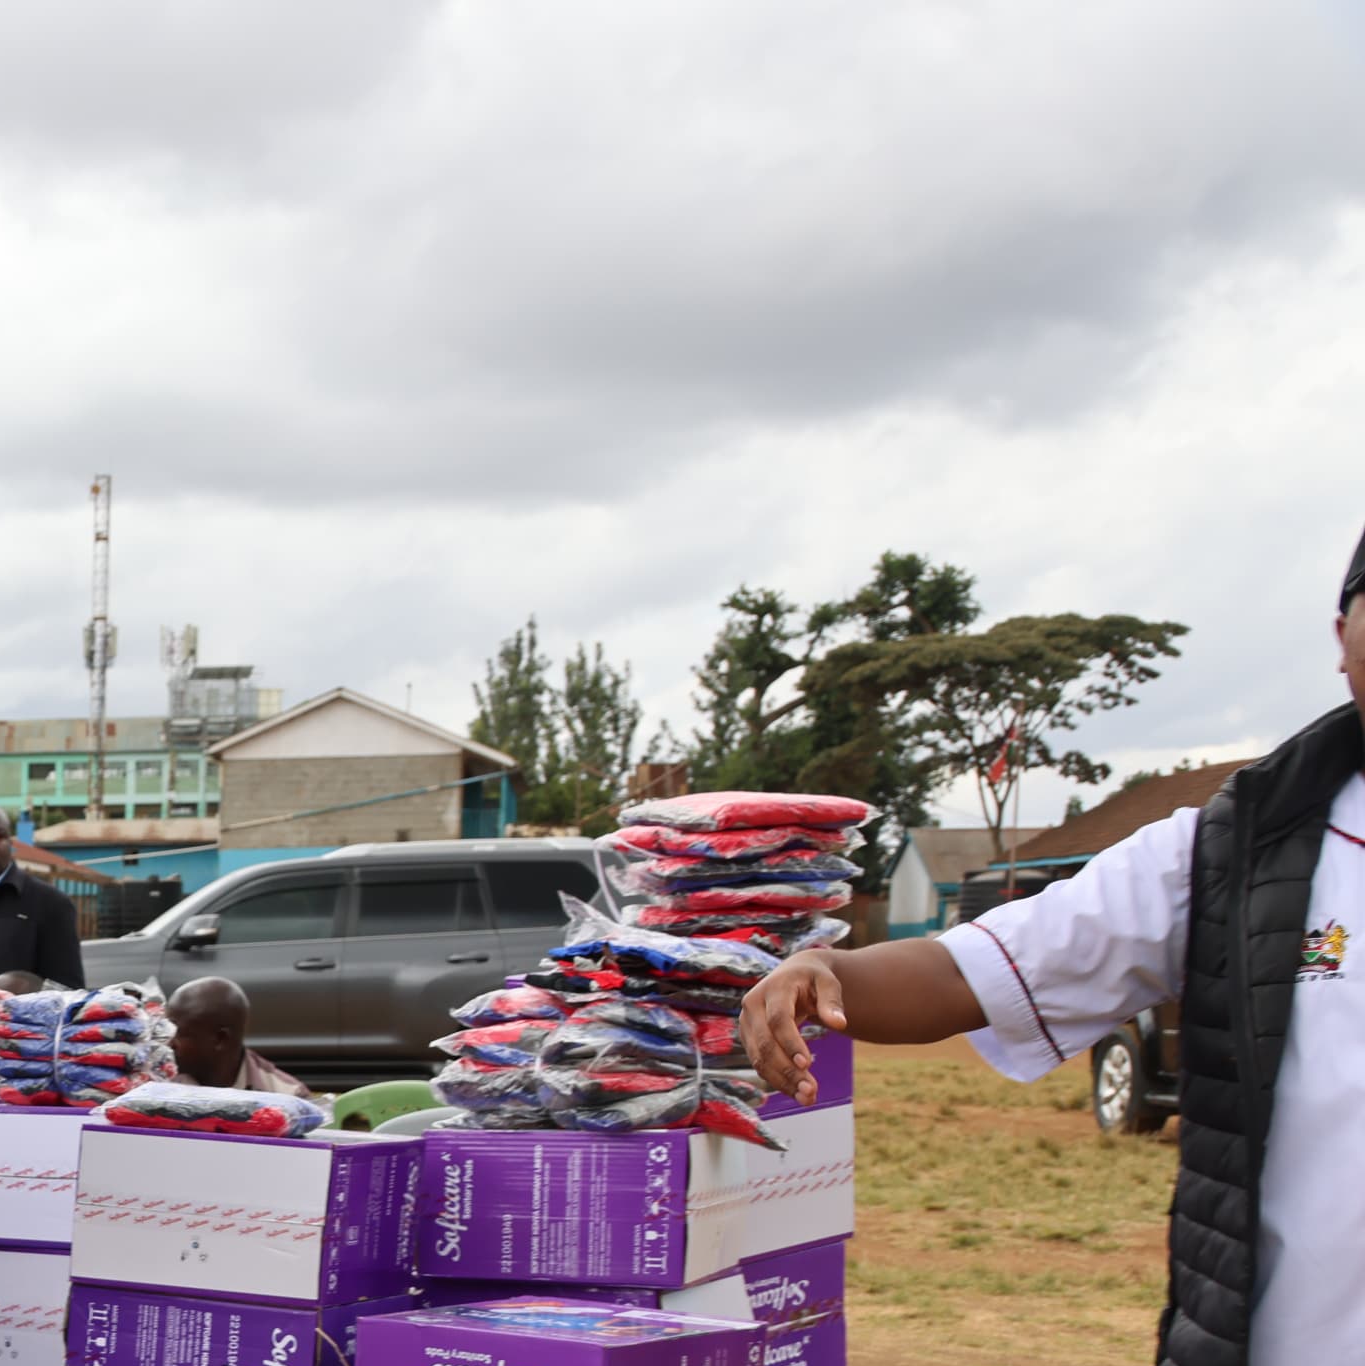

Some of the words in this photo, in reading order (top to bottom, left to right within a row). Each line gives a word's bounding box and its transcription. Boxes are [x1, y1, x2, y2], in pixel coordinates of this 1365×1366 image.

[463, 1159, 474, 1178] Pads
[462, 1179, 474, 1219] Sanitary
[435, 1164, 468, 1262] Softcare
[748, 1277, 810, 1311] Softcar
[425, 1347, 450, 1359] Pads
[450, 1350, 492, 1364] Sanitary
